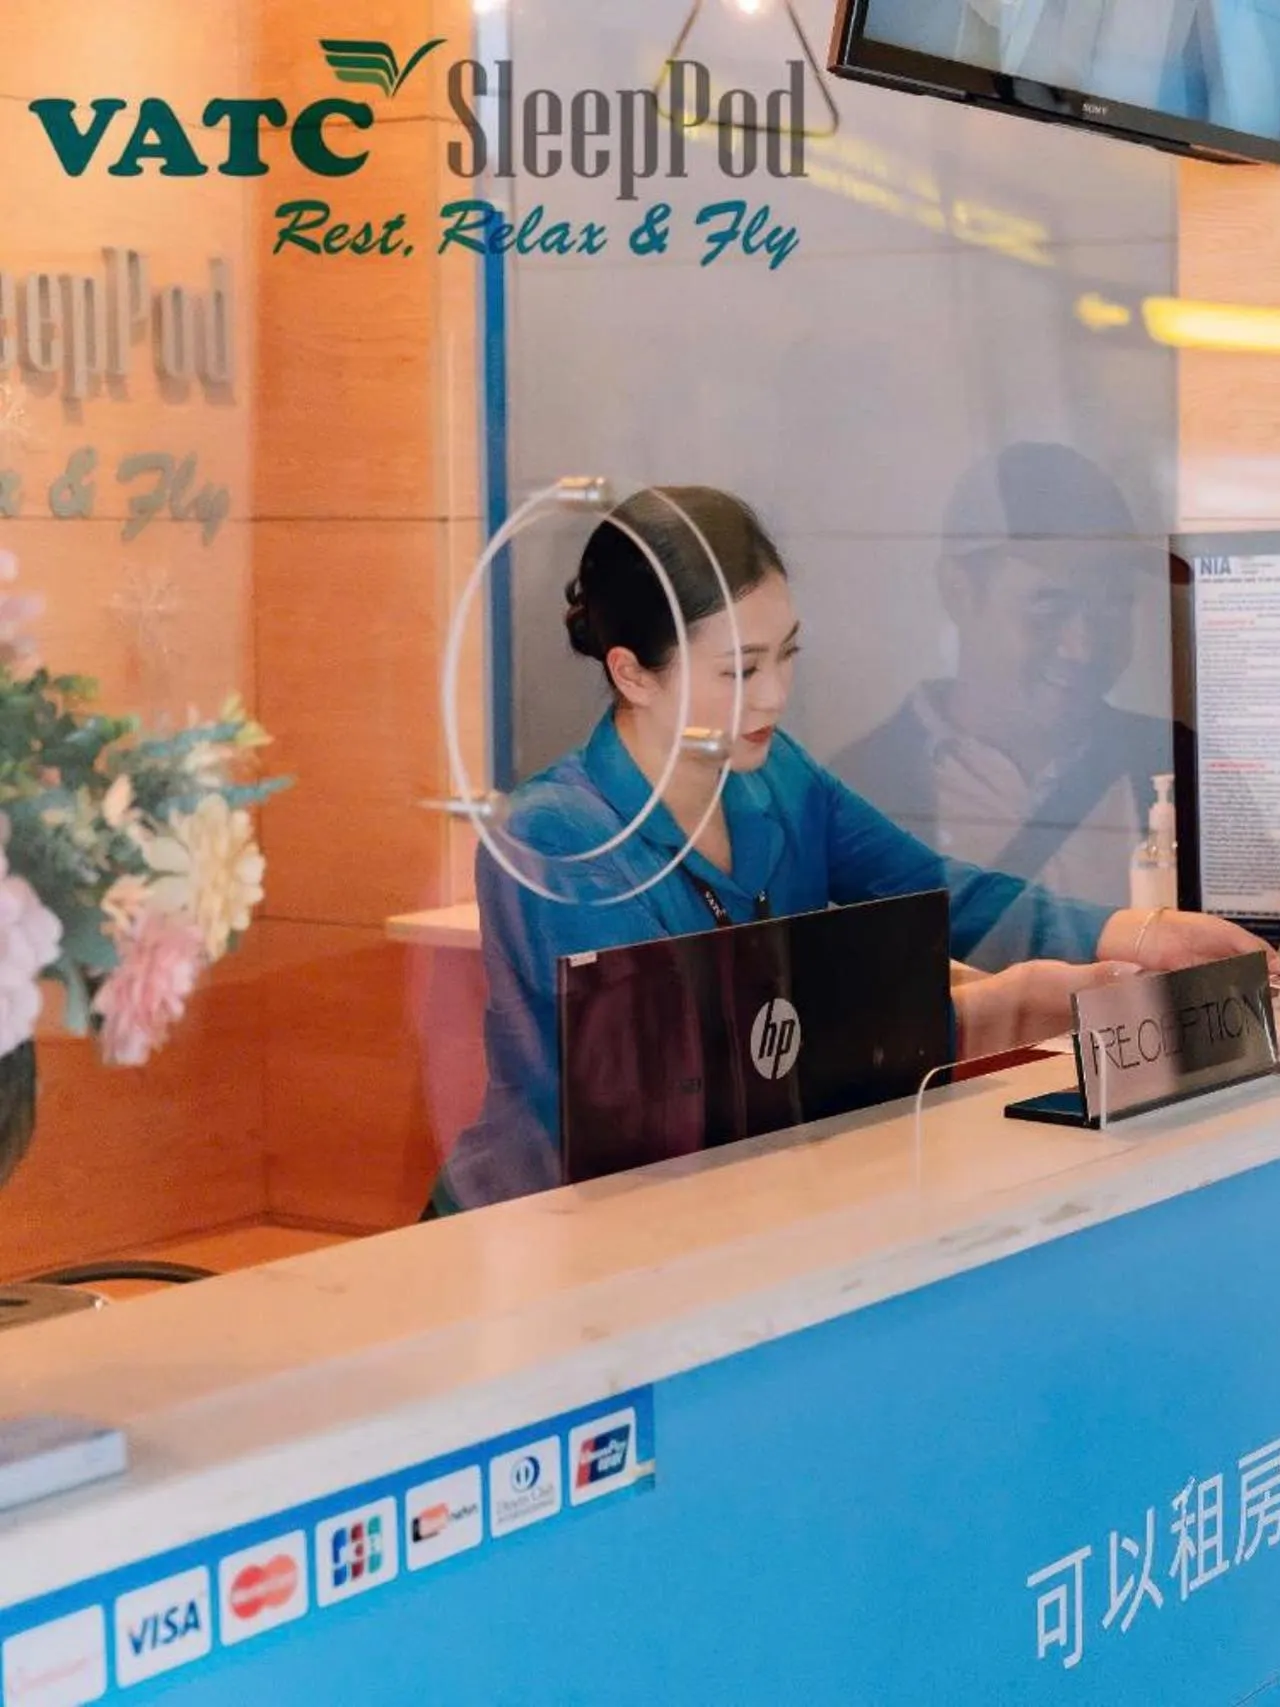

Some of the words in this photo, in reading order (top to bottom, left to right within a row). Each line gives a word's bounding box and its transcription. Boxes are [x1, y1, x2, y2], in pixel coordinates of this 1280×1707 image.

[116, 452, 231, 546] Fly
[755, 998, 799, 1080] hp
[1090, 991, 1266, 1075] RECEPTION
[127, 1600, 202, 1655] VISA
